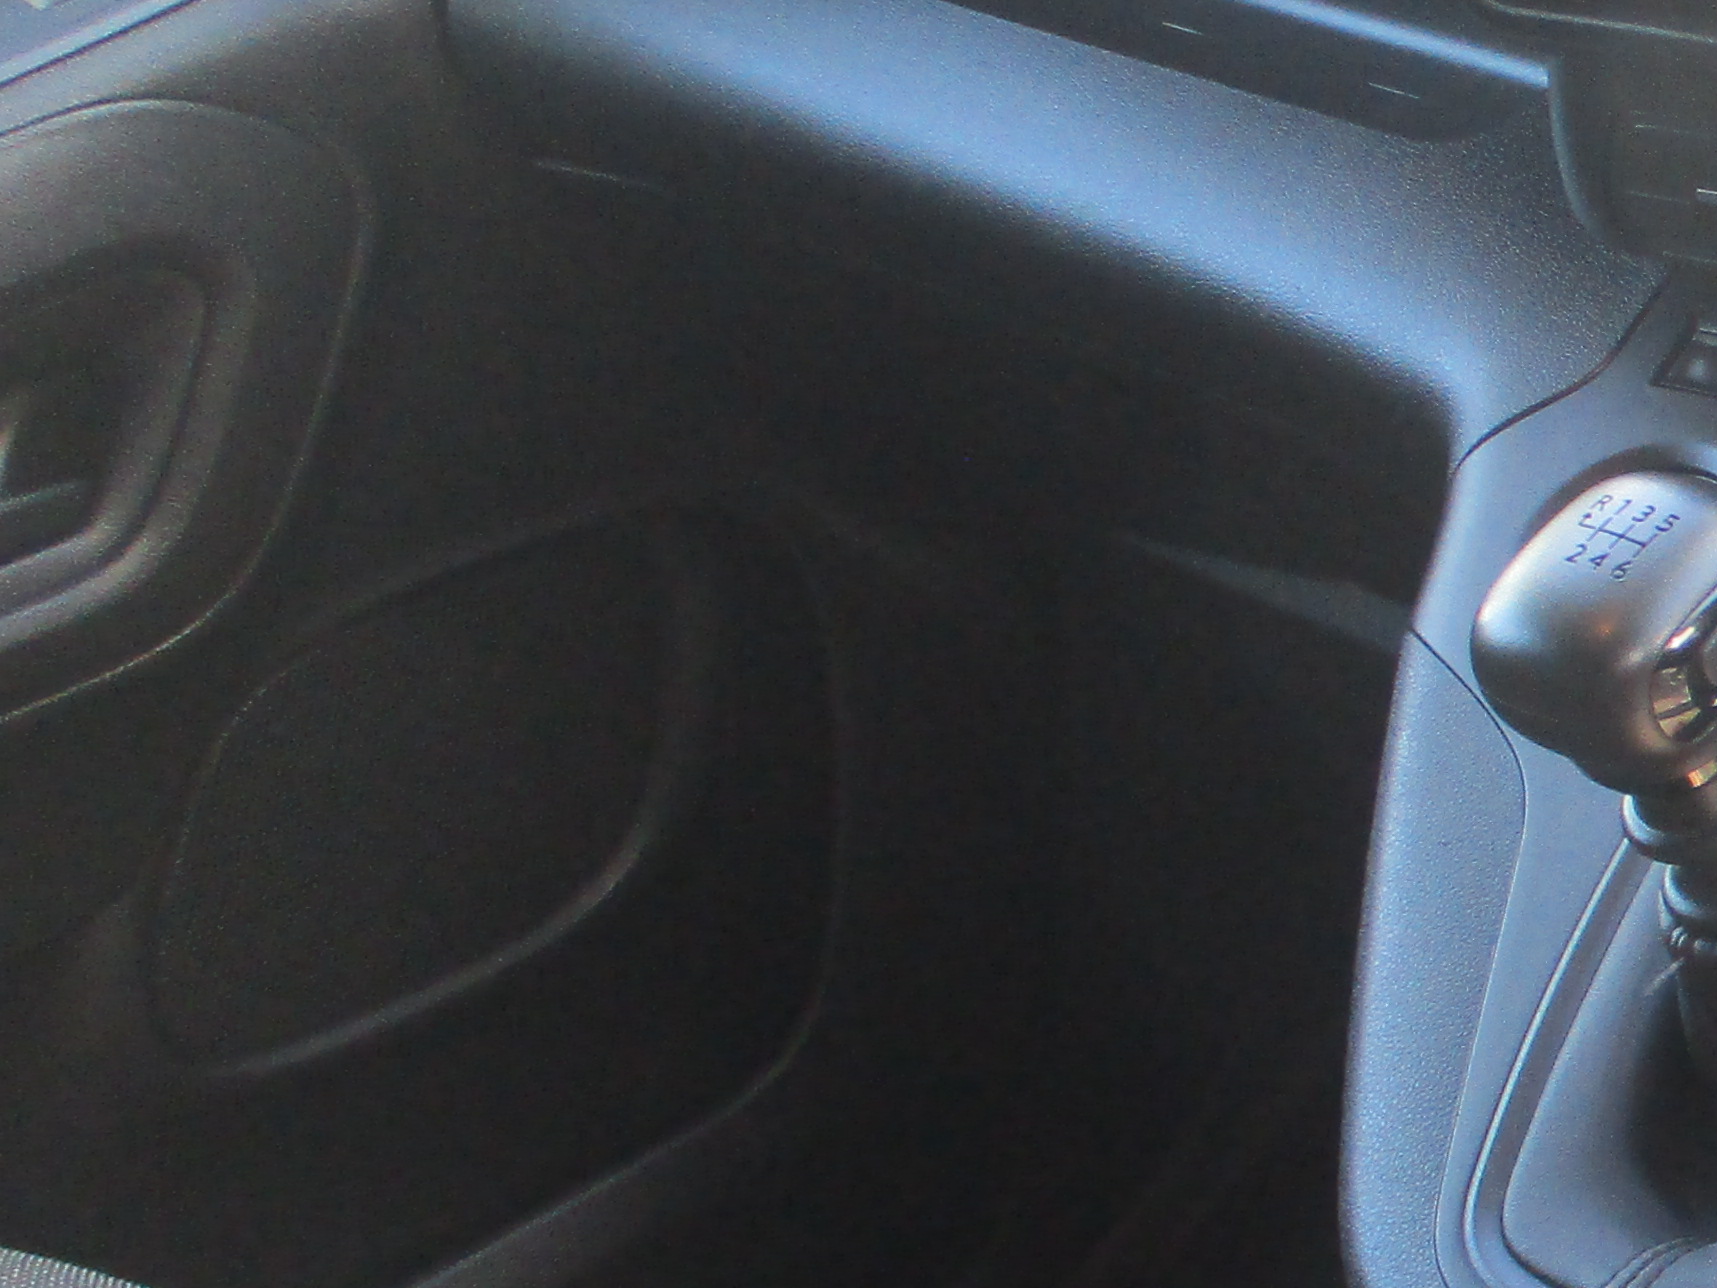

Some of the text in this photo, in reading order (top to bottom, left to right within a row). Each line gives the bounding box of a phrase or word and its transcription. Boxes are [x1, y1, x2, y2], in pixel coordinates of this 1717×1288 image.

[1589, 494, 1681, 532] R 1 3 5
[1564, 543, 1633, 582] 2 4 6
